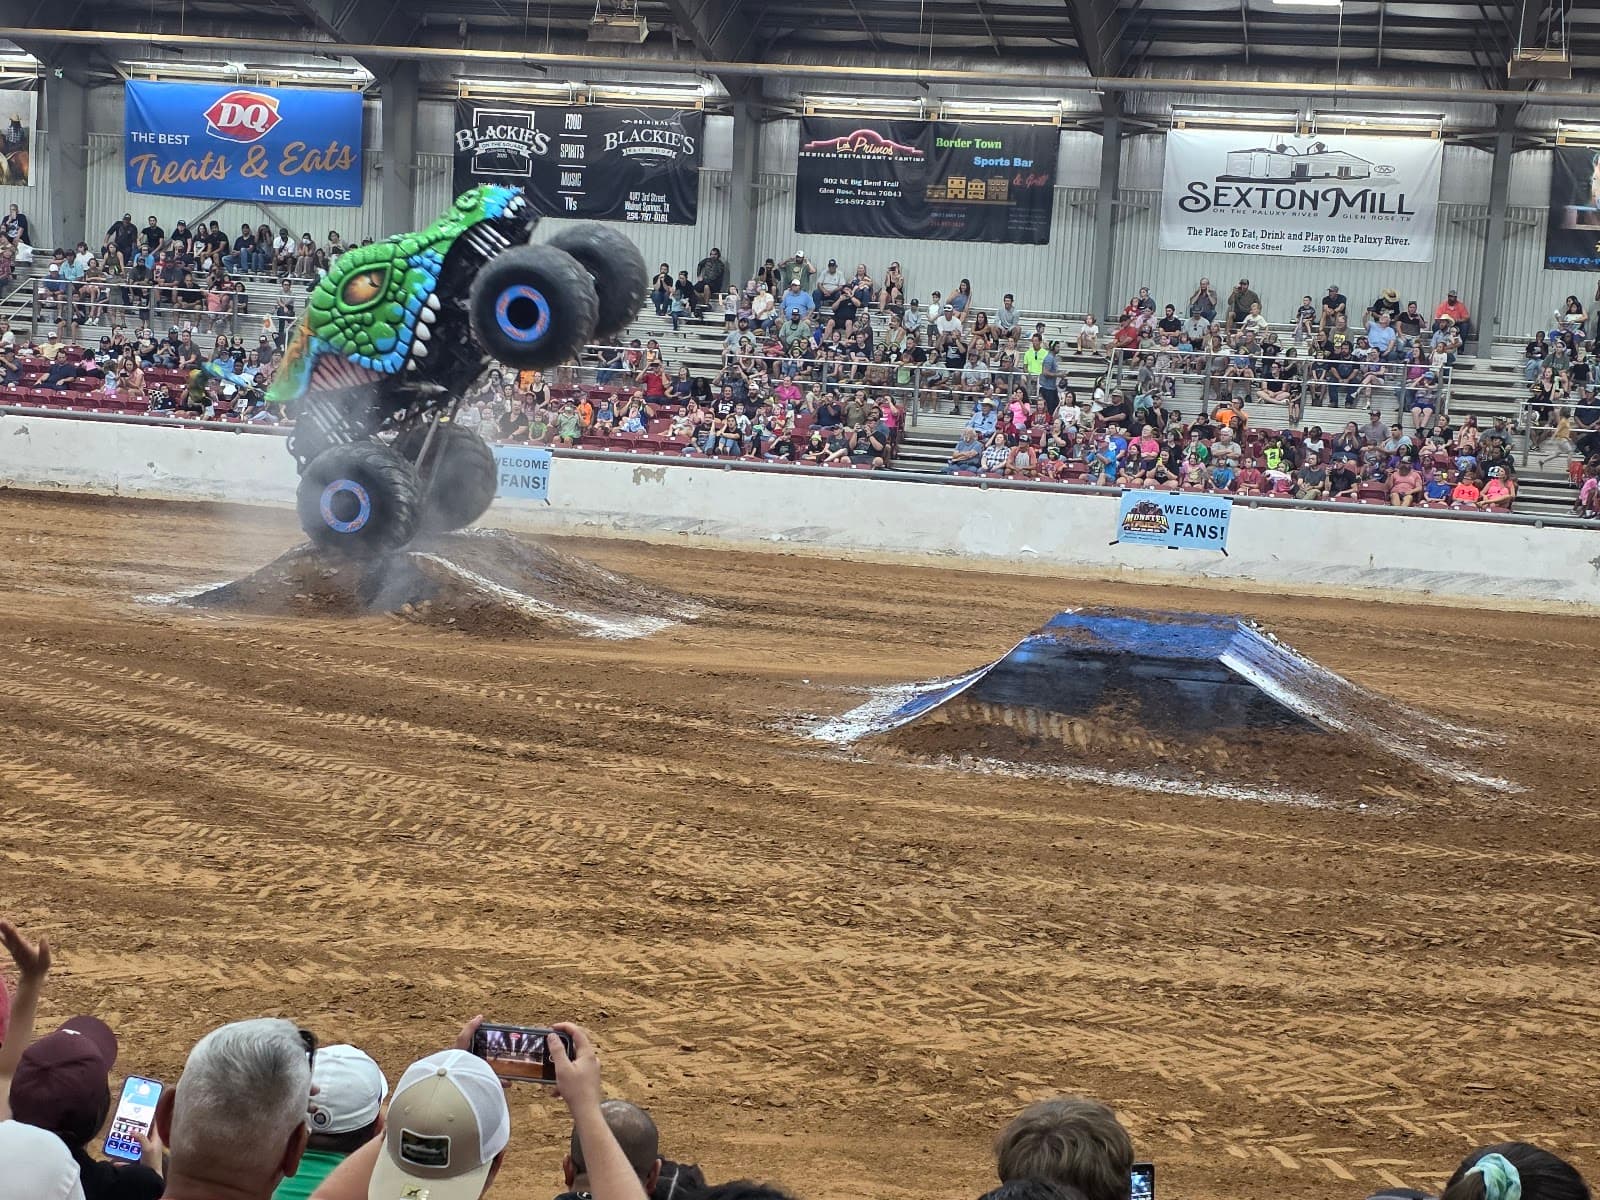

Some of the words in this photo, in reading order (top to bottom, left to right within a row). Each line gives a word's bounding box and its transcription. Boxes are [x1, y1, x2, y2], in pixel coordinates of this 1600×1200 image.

[217, 102, 266, 133] DQ
[565, 113, 582, 130] FOOD
[131, 131, 155, 144] THE
[158, 133, 190, 145] BEST
[455, 125, 551, 155] BLACKIE'S
[603, 128, 695, 155] BLACKIE'S
[853, 136, 894, 155] Primos
[936, 137, 972, 148] Border
[974, 138, 1002, 149] Town
[560, 143, 585, 159] SPIRITS
[130, 151, 232, 189] Treats
[240, 144, 269, 179] &
[278, 140, 357, 177] Eats
[973, 156, 1011, 168] Sports
[1013, 157, 1034, 168] Bar
[560, 171, 582, 187] MUSIC
[883, 180, 899, 188] Trail
[260, 185, 274, 197] IN
[278, 186, 312, 199] GLEN
[316, 188, 351, 201] ROSE
[1178, 181, 1319, 213] SEXTON
[1320, 187, 1416, 218] MILL
[564, 196, 578, 211] TVs
[1187, 226, 1203, 237] The
[1205, 227, 1229, 238] Place
[1230, 228, 1240, 238] To
[1241, 228, 1259, 240] Eat,
[1260, 229, 1286, 240] Drink
[1287, 231, 1303, 241] and
[1304, 231, 1325, 244] Play
[1325, 234, 1337, 243] on
[1338, 233, 1352, 243] the
[1353, 234, 1384, 247] Paluxy
[1384, 235, 1411, 246] River.
[1223, 240, 1236, 249] 100
[1237, 241, 1260, 250] Grace
[1260, 241, 1283, 251] Street
[500, 473, 547, 490] FANS!
[1125, 513, 1167, 525] MONSTER
[1164, 504, 1229, 519] WELCOME
[1173, 522, 1225, 540] FANS!
